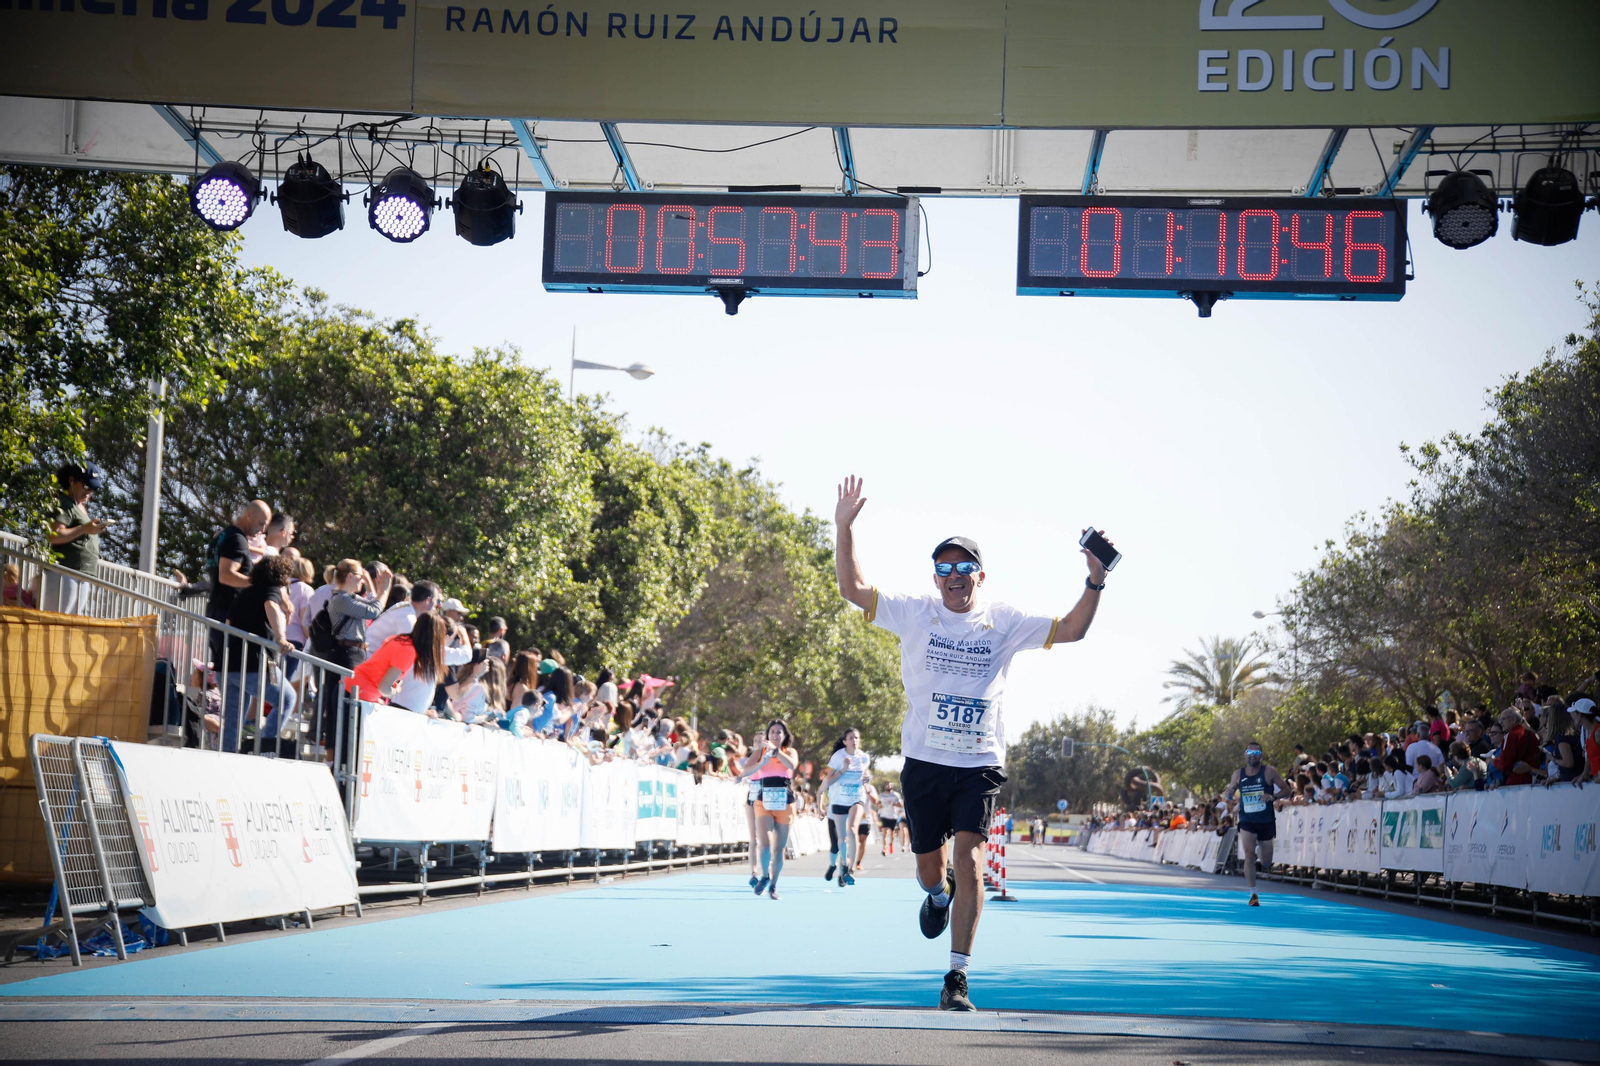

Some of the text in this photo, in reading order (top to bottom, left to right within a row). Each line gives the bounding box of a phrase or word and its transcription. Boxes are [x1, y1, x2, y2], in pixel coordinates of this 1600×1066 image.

[445, 4, 898, 44] RAMÓN RUIZ ANDÚJAR
[1198, 36, 1450, 92] EDICIÓN
[1080, 206, 1387, 283] 01:10:46
[926, 648, 948, 657] RAMÓN
[949, 652, 964, 660] RUIZ
[966, 646, 992, 655] 2024
[936, 704, 985, 725] 5187
[160, 792, 216, 833] ALMERÍA
[167, 842, 200, 864] CIUDAD
